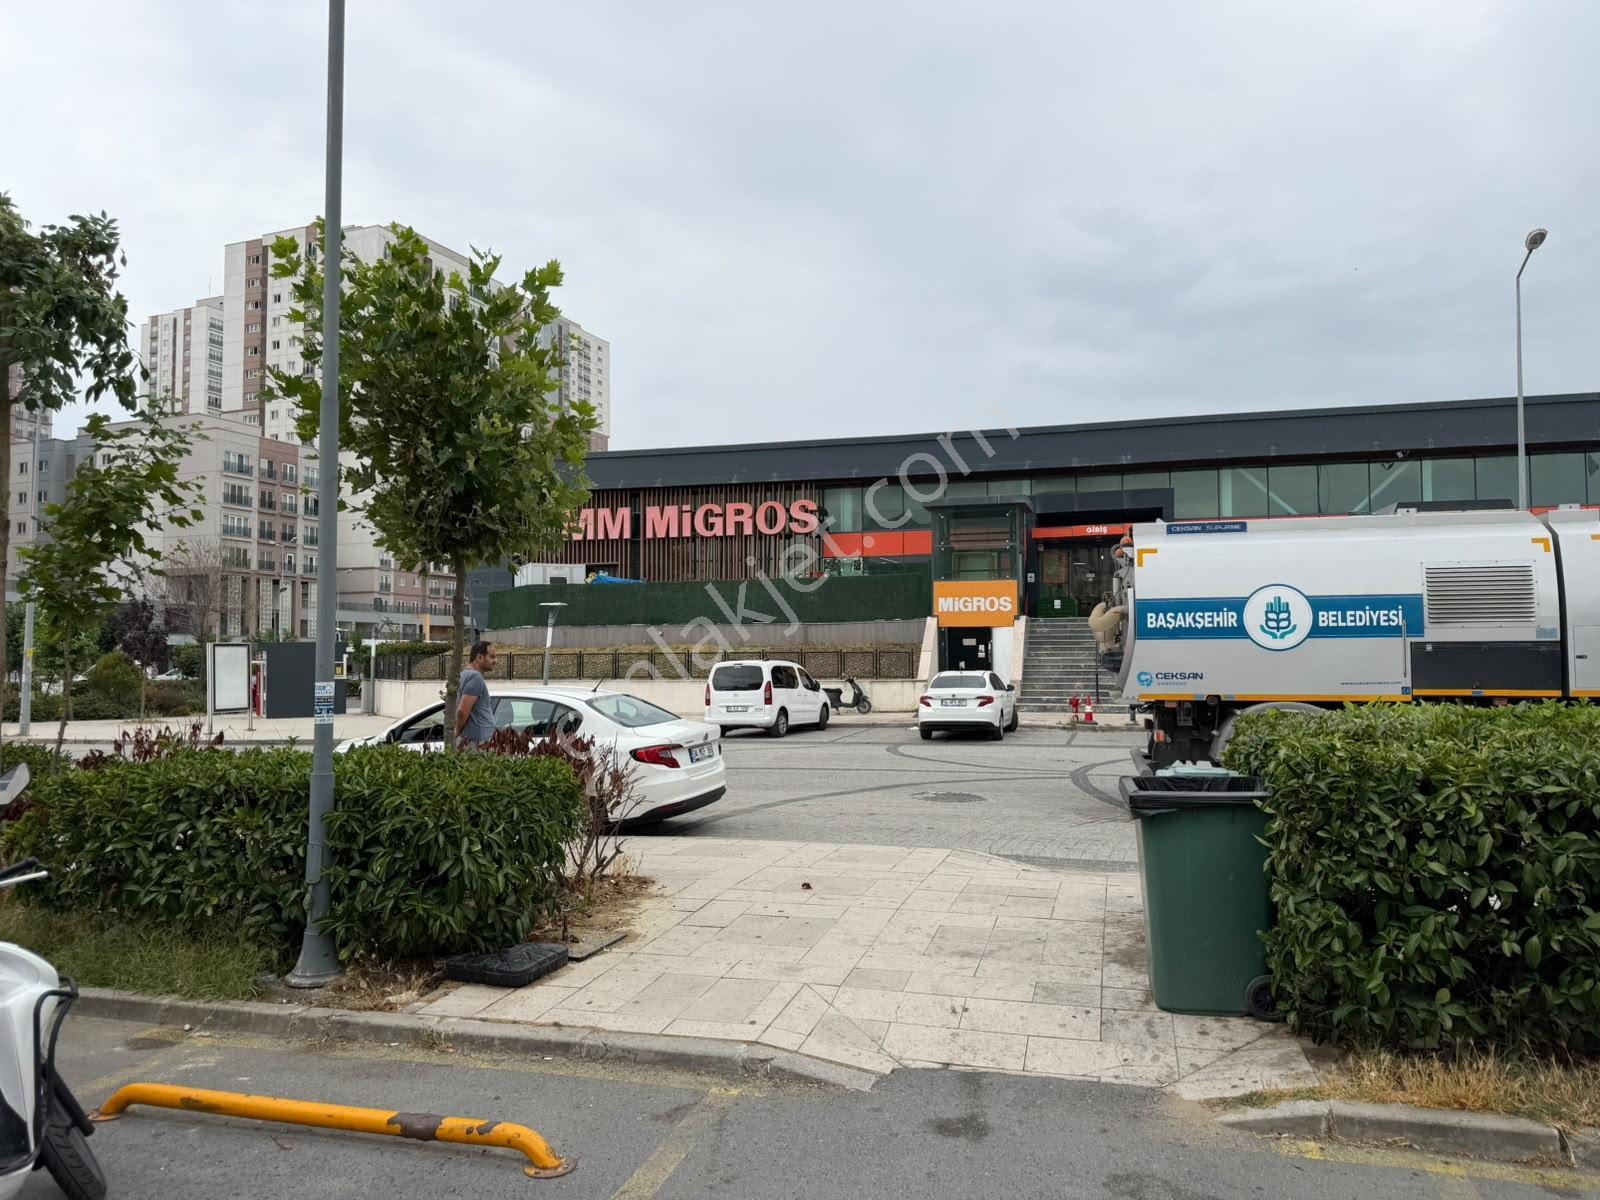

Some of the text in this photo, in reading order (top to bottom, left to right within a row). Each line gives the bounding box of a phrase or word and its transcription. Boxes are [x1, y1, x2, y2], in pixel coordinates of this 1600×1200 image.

[1146, 605, 1403, 630] BAŞAKŞEHİR BELEDİYESİ
[1155, 672, 1204, 680] CEKSAN
